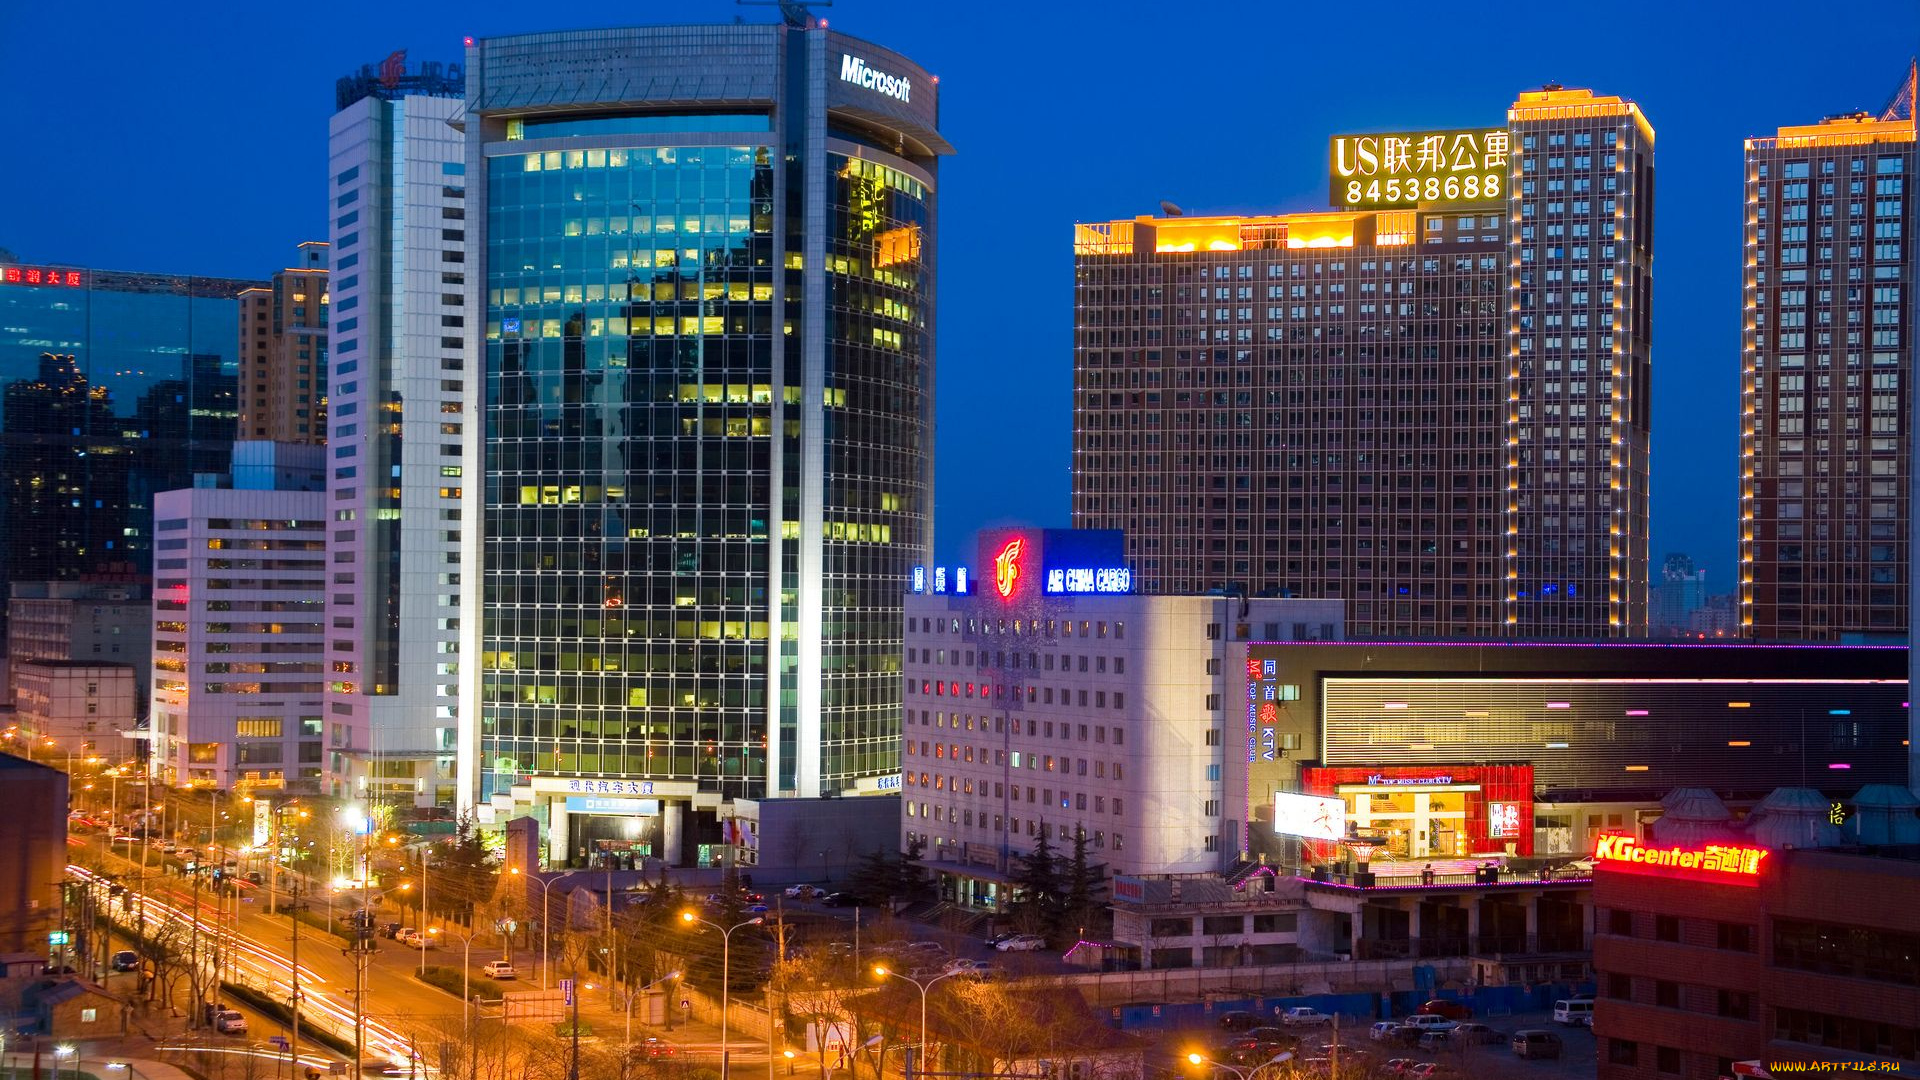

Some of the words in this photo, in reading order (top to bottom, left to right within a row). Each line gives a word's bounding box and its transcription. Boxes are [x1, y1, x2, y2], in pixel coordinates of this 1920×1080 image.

[841, 54, 911, 103] Microsoft
[1346, 174, 1500, 204] 84538688
[1047, 569, 1064, 593] AIR
[1066, 568, 1095, 592] CHINA
[1096, 567, 1131, 593] CARGO
[1263, 728, 1275, 761] KTV
